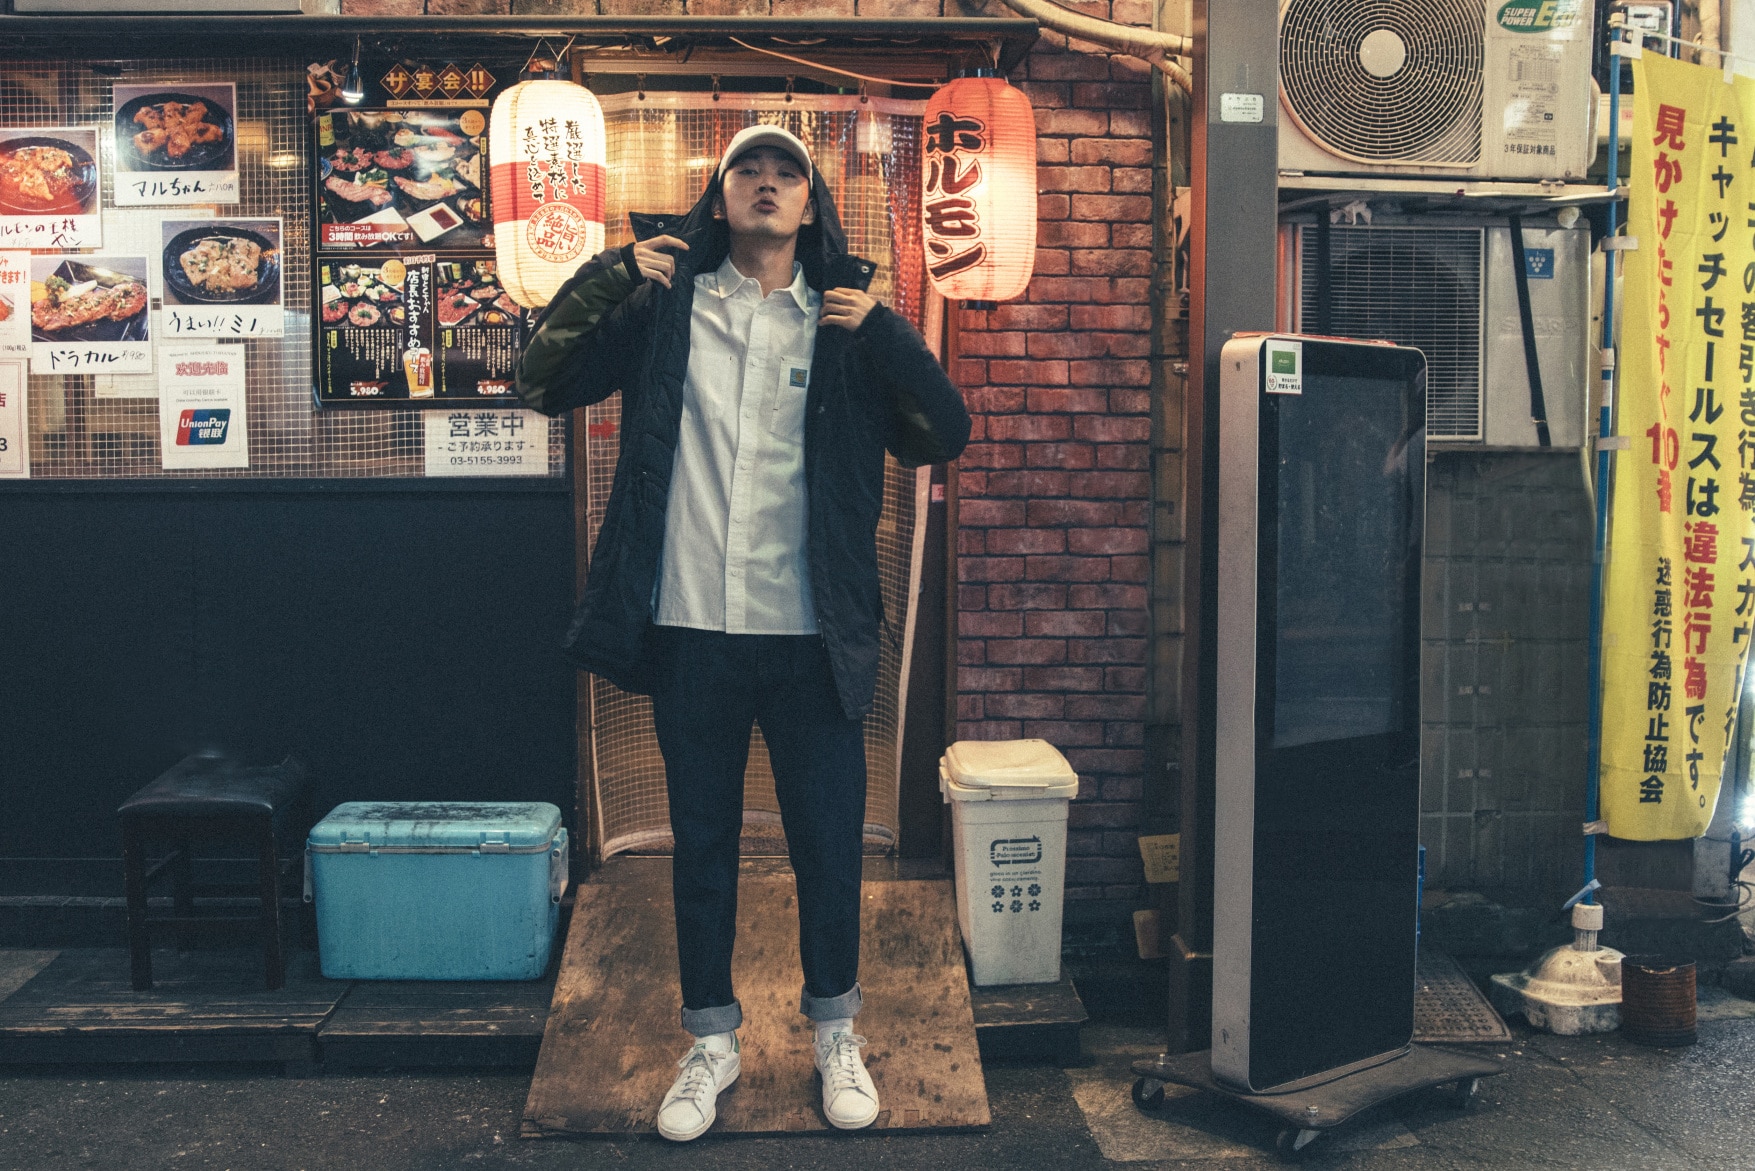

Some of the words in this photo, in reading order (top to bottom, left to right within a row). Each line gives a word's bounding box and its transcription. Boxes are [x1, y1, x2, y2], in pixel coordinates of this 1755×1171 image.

[1501, 16, 1534, 26] POWER
[1503, 7, 1537, 17] SUPER
[539, 118, 568, 200] 特選素材に
[565, 121, 586, 195] 厳選した
[1504, 143, 1556, 156] 3年保証対象商品
[132, 177, 205, 197] マルちゃん
[926, 112, 984, 280] ホルモン
[537, 212, 565, 248] 絶品
[558, 224, 578, 250] 旨い
[181, 417, 227, 430] UnionPay
[198, 428, 222, 438] 银联
[448, 412, 524, 437] 営業中
[450, 456, 522, 465] 03-5155-3993
[1684, 115, 1738, 808] キャッチセールスは違法行為です。
[1640, 556, 1672, 805] 迷惑行為防止協会
